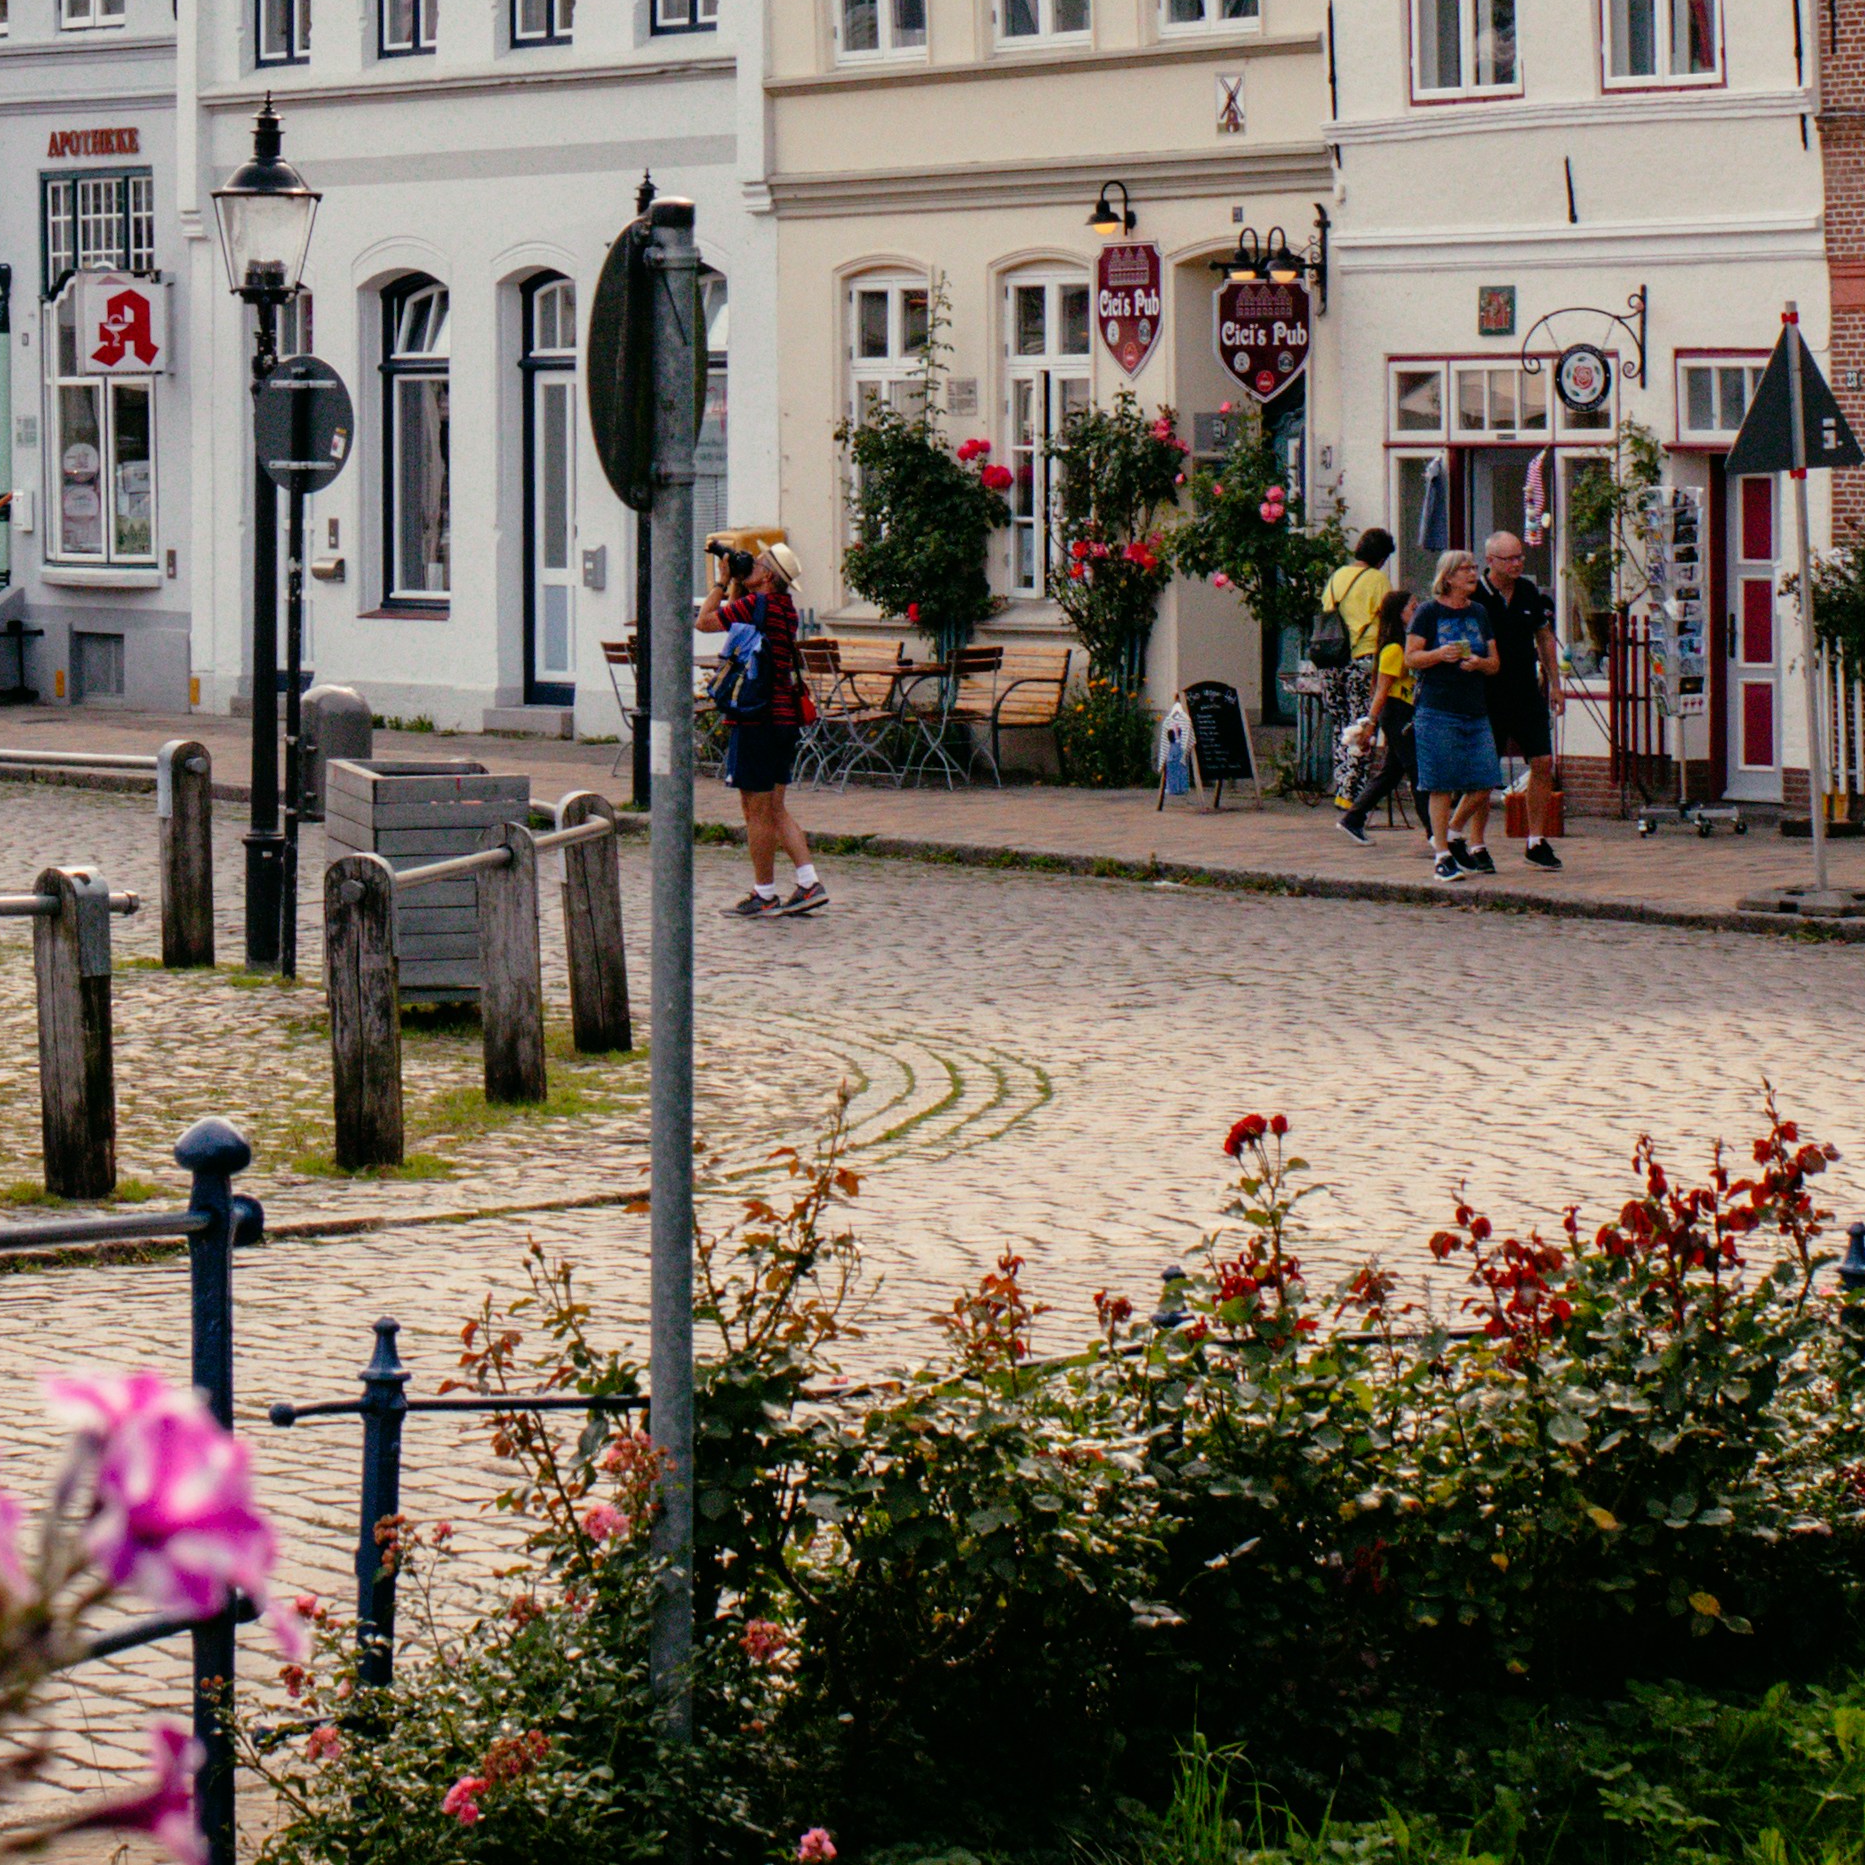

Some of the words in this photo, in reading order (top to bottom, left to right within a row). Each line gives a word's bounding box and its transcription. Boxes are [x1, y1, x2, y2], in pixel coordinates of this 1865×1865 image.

[48, 126, 141, 158] APOTHEKE
[1098, 289, 1131, 317] Cici's
[1134, 288, 1160, 317] Pub
[1221, 321, 1267, 347] Cici's
[1272, 321, 1308, 347] Pub
